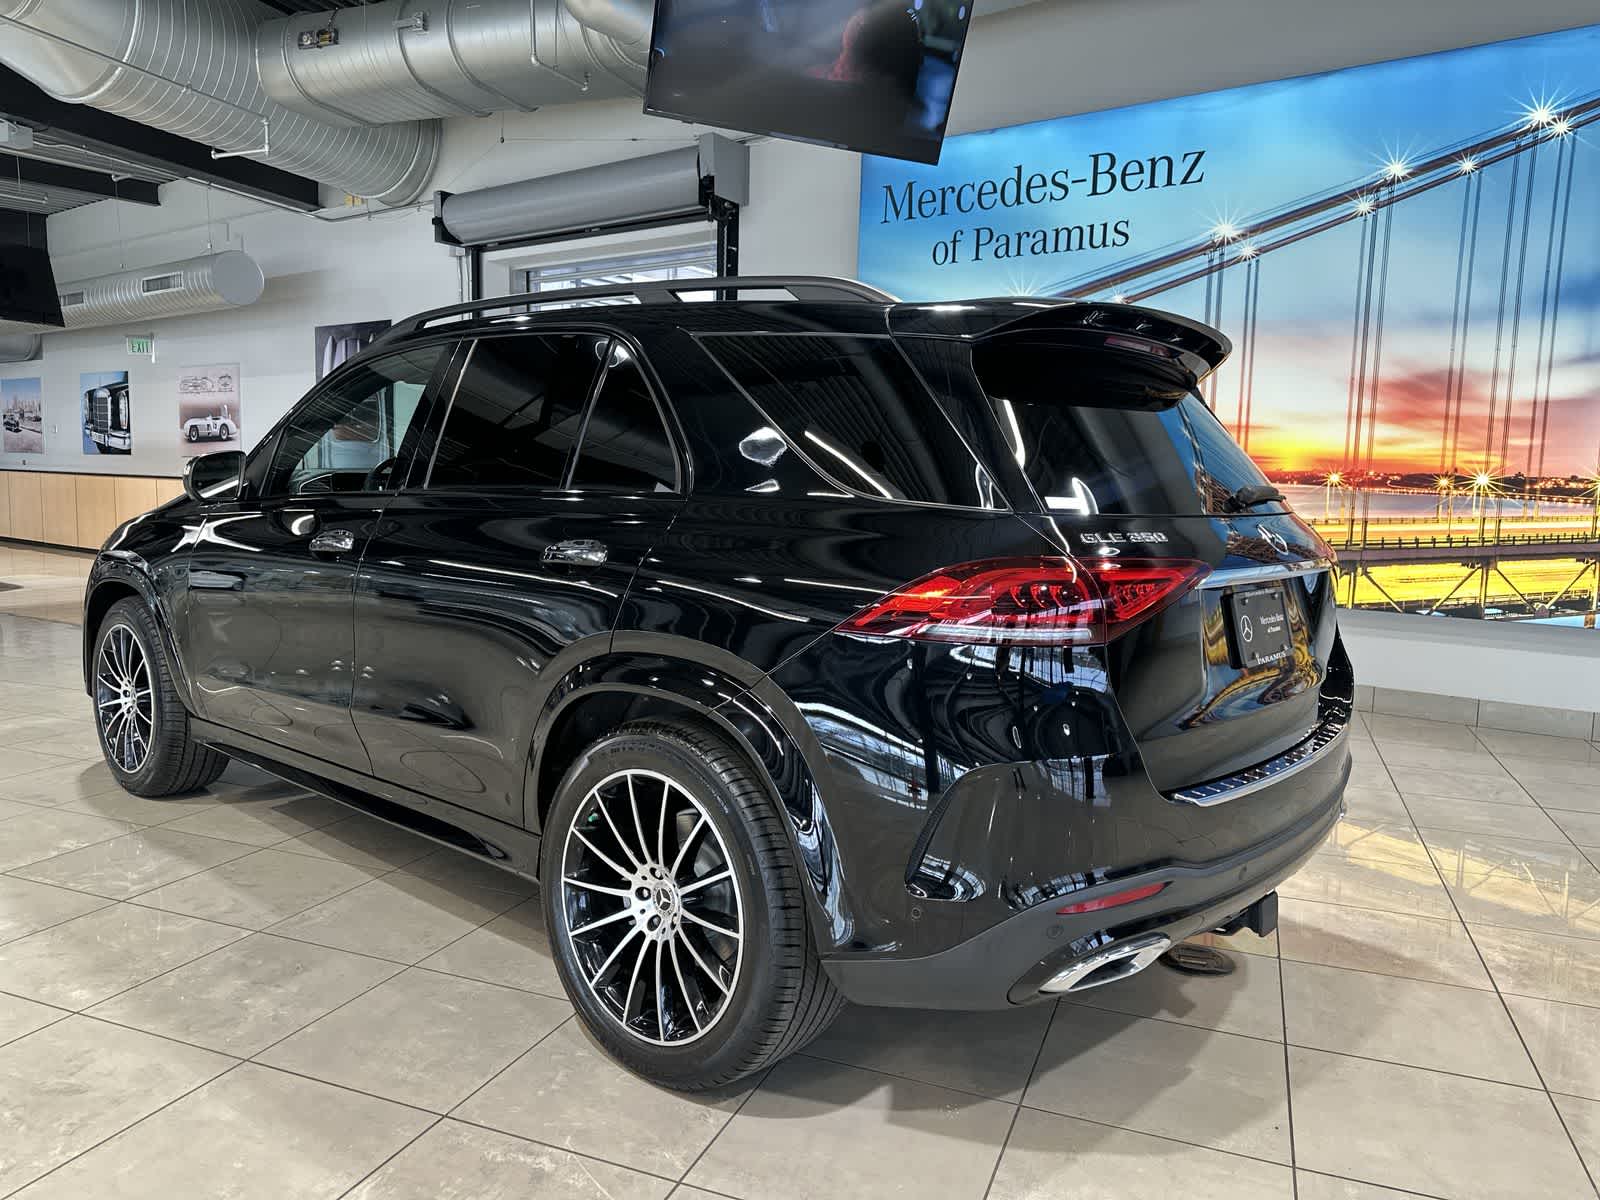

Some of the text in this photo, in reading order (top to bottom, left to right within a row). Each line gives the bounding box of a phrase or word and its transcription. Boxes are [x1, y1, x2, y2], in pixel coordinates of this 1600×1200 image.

[880, 150, 1207, 224] Mercedes-Benz
[932, 218, 1130, 266] of Paramus
[131, 341, 150, 352] EXIT
[1080, 532, 1126, 544] GLE
